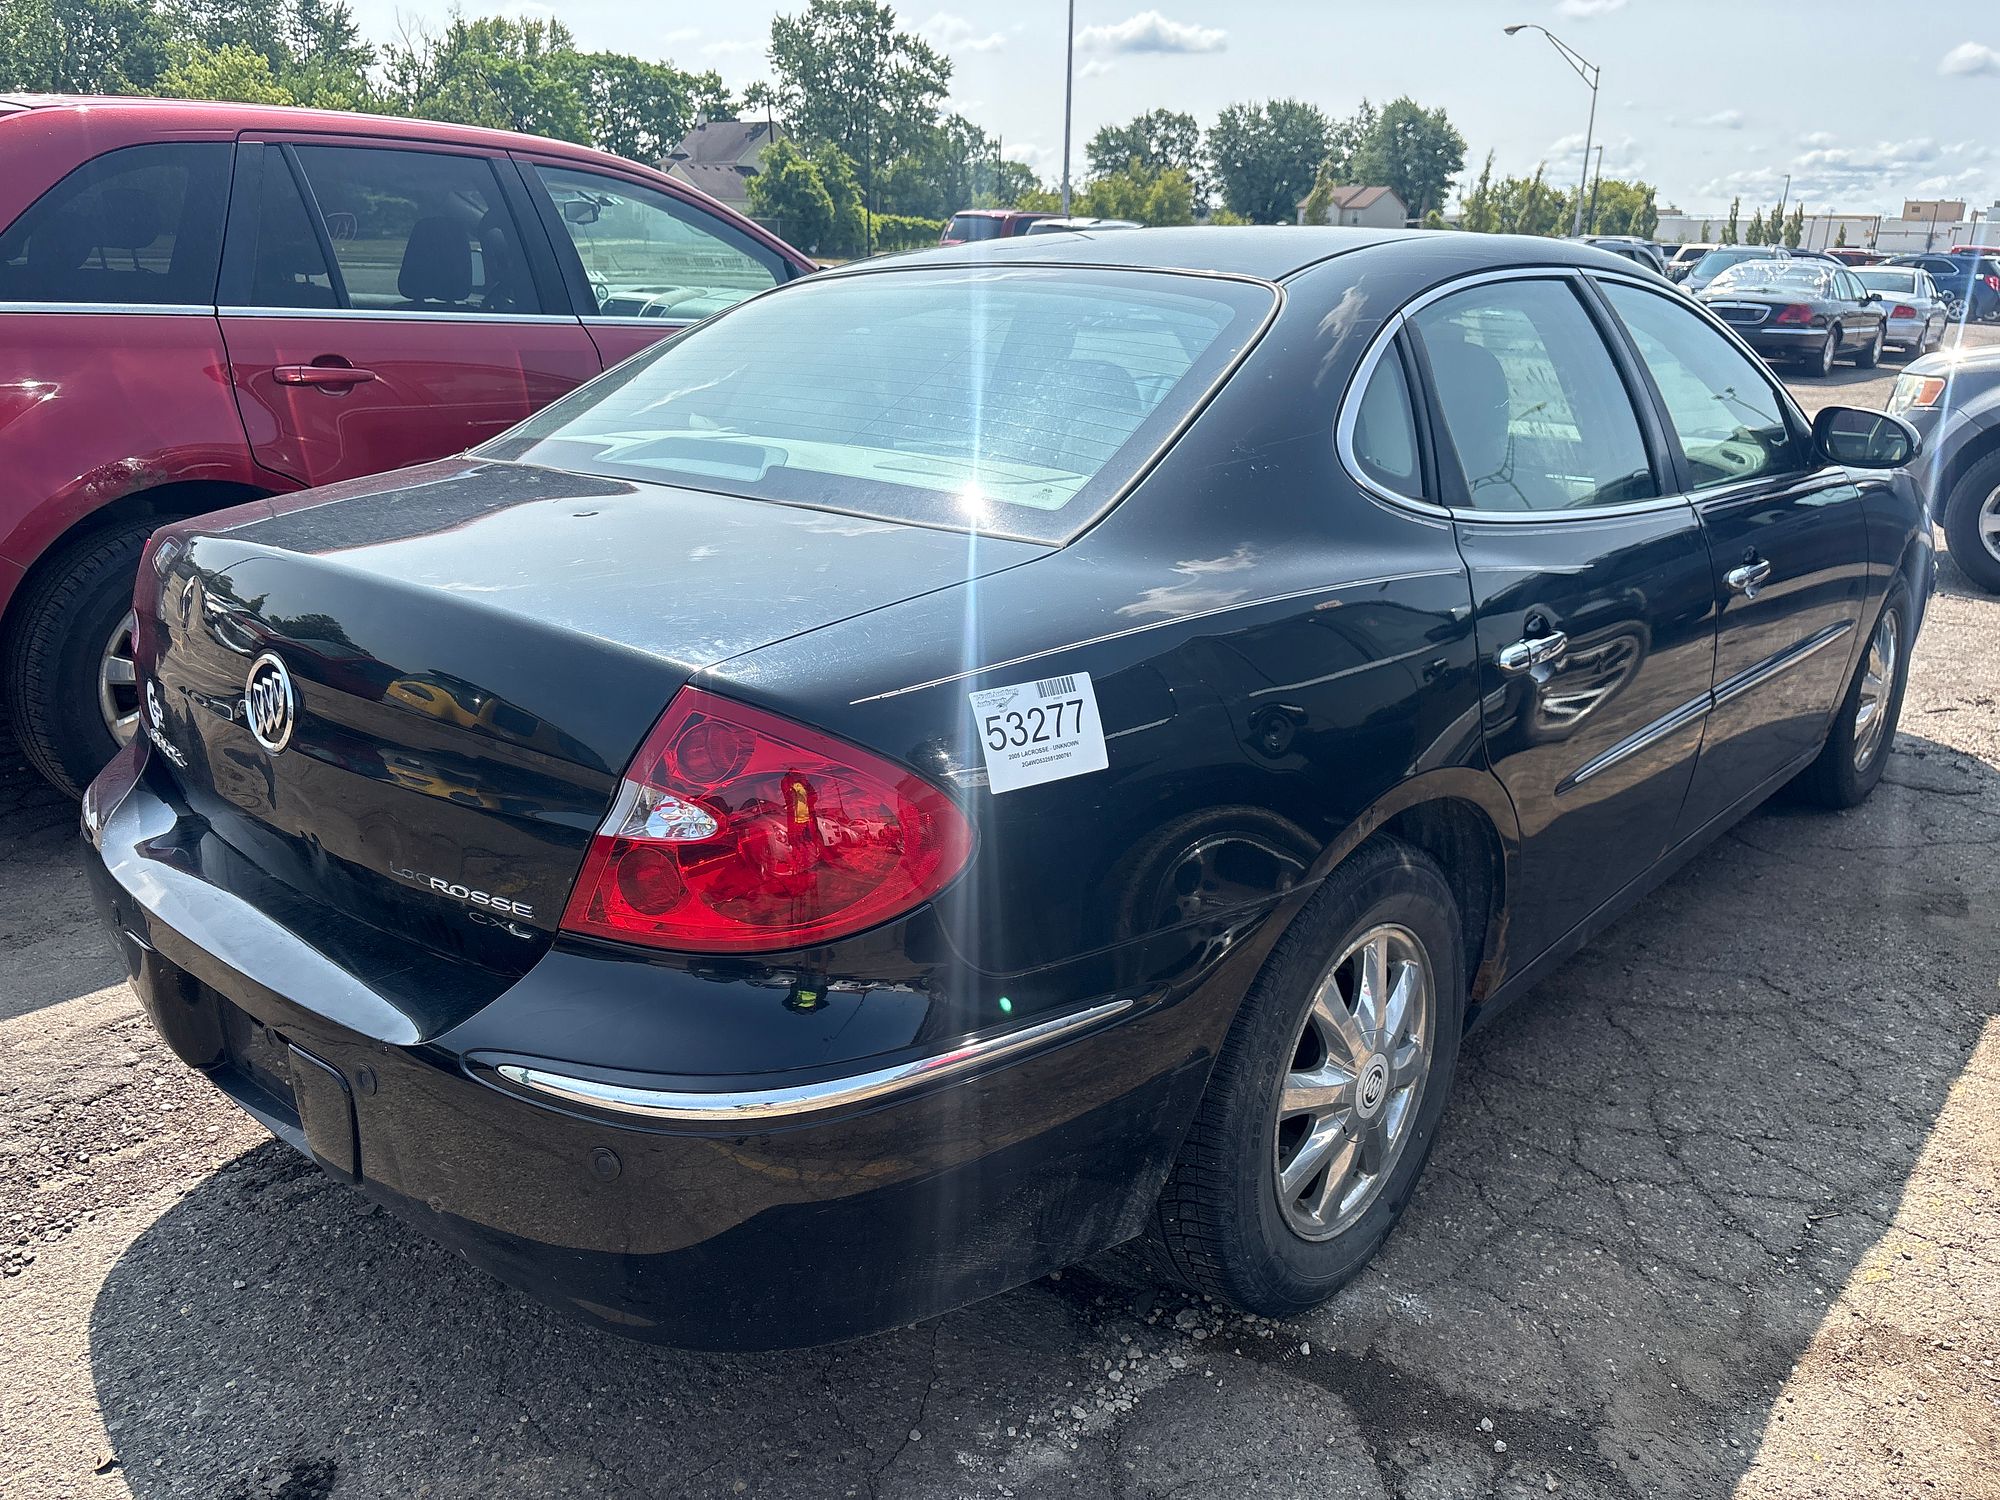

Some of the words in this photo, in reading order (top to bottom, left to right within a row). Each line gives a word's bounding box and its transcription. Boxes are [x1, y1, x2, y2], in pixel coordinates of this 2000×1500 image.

[986, 699, 1083, 751] 53277
[1021, 746, 1049, 757] LACROSSE
[1053, 740, 1079, 750] UNKNOWN
[469, 912, 532, 939] CXL
